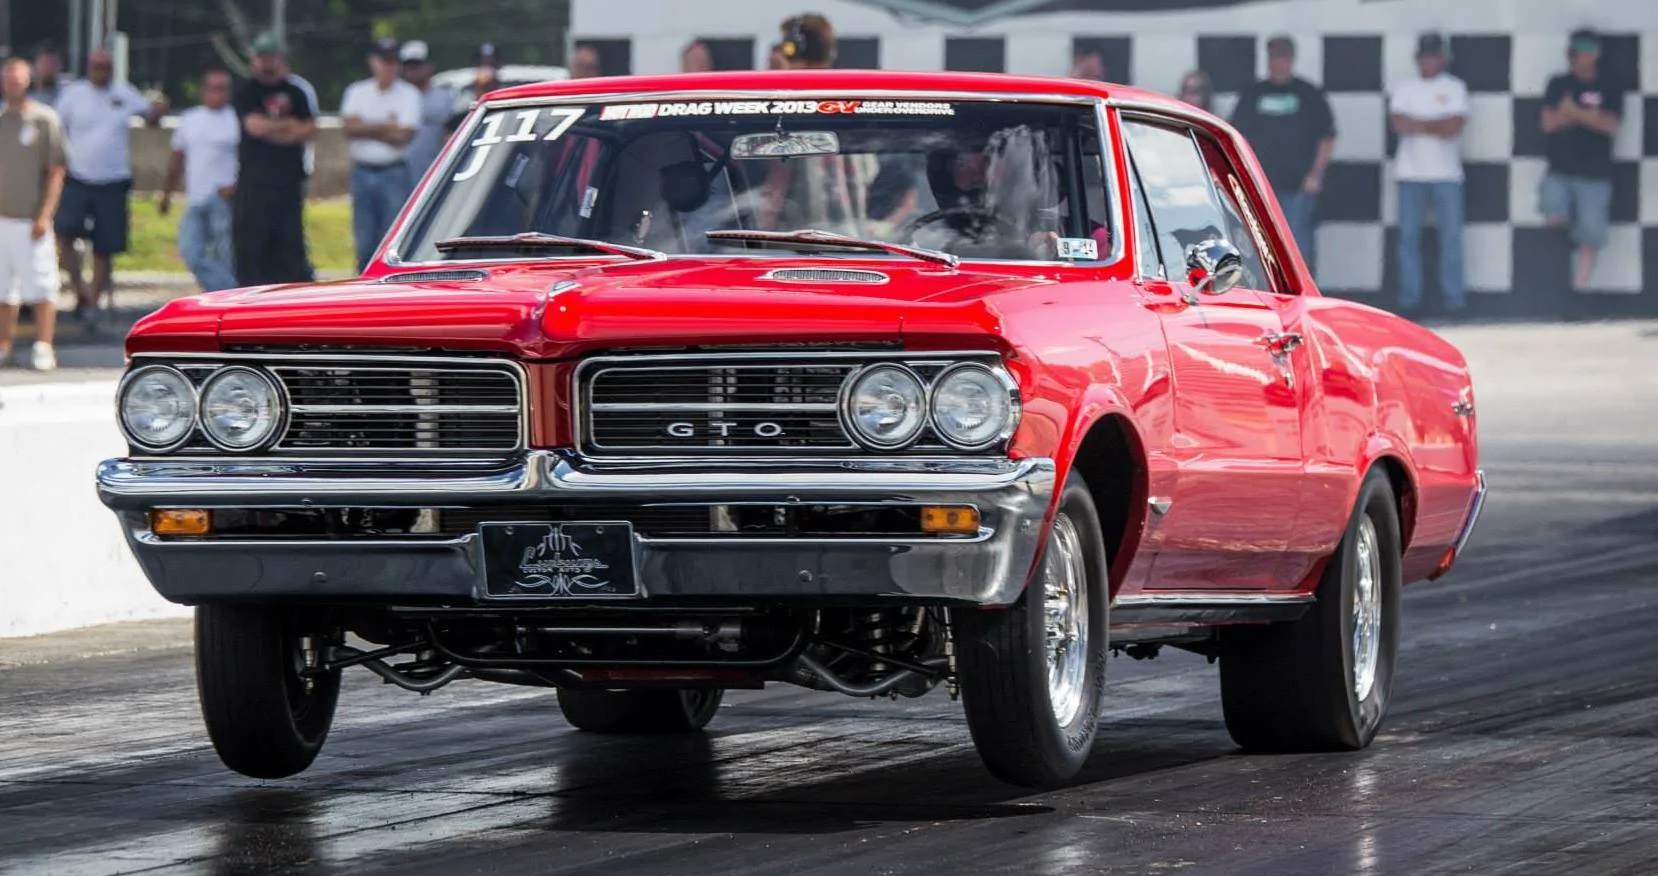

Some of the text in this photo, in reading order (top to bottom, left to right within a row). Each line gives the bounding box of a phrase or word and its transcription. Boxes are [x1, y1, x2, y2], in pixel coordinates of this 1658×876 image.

[657, 102, 714, 117] DRAG
[713, 101, 771, 115] WEEK
[769, 100, 819, 115] 2013
[471, 107, 586, 146] 117
[453, 144, 493, 182] J
[667, 422, 783, 437] GTO
